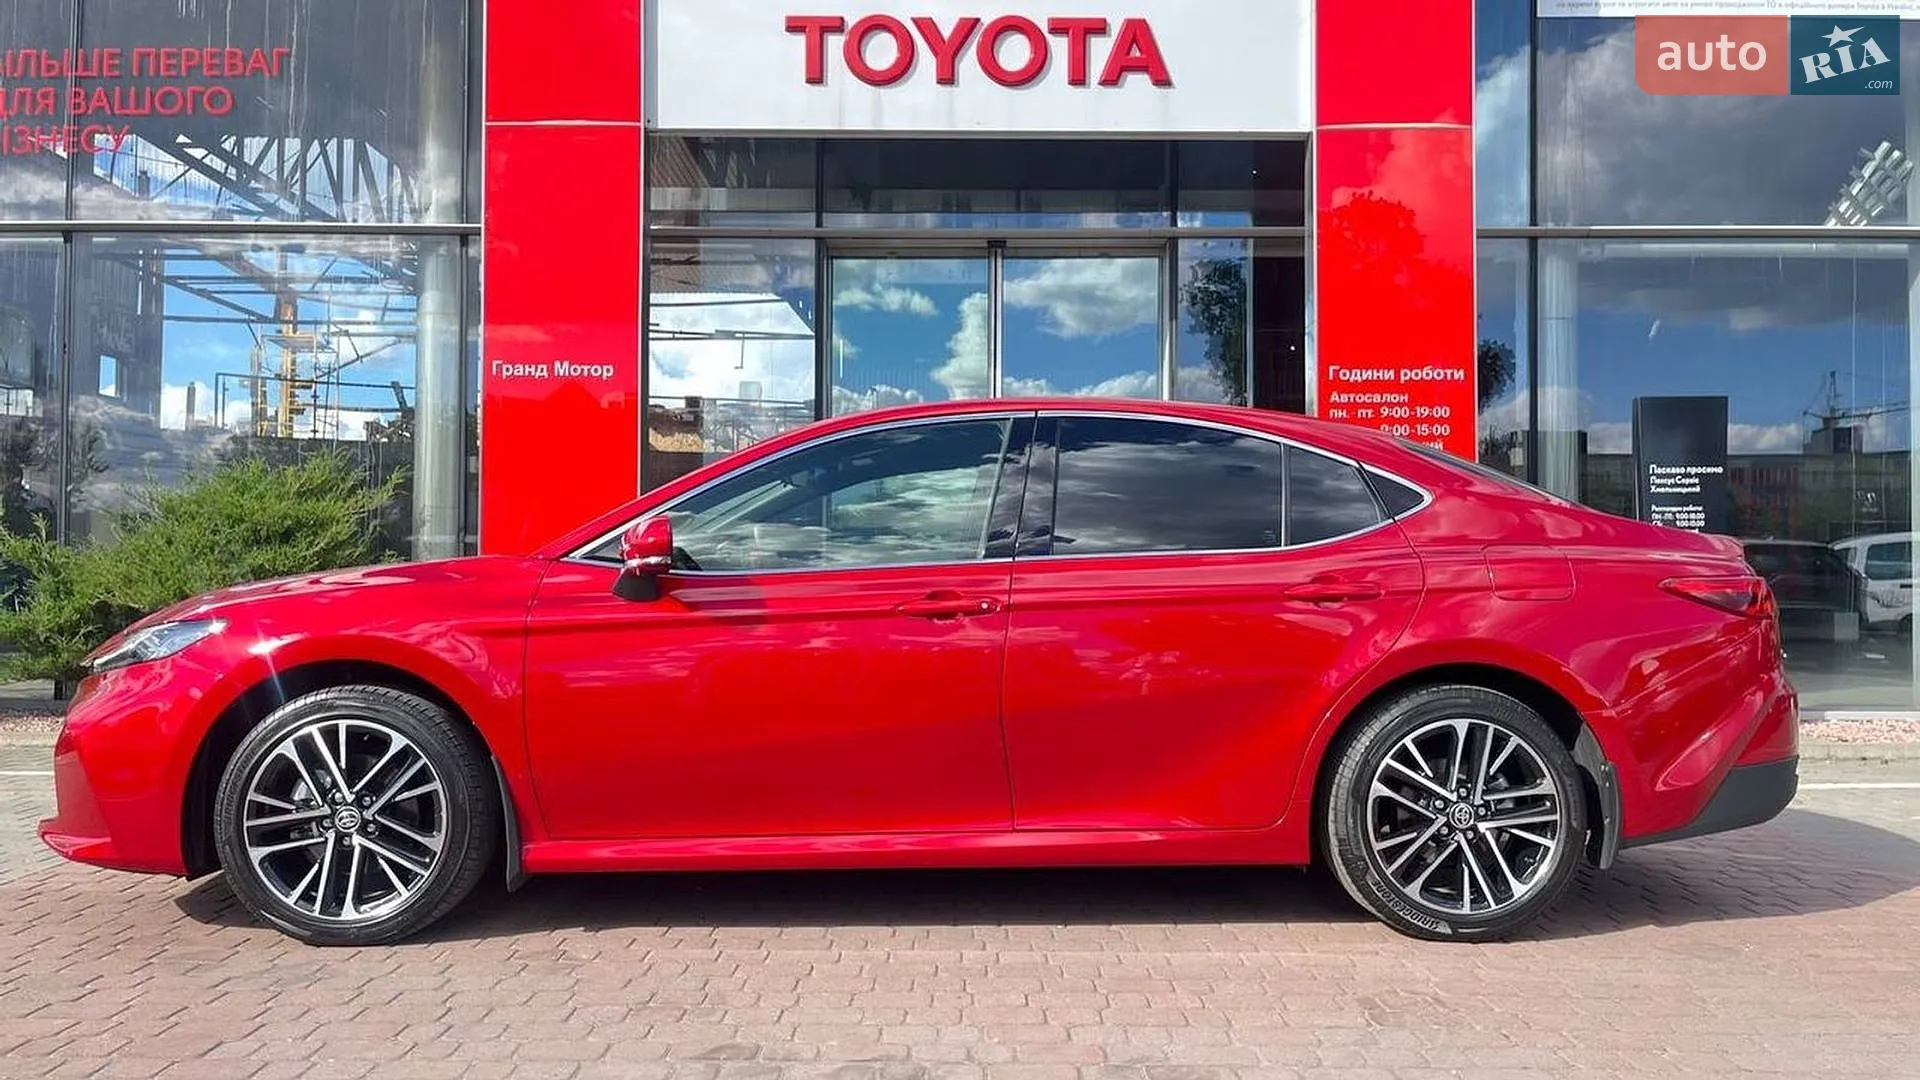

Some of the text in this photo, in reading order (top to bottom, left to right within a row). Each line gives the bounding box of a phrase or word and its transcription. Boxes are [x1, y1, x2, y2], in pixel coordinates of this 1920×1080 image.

[0, 46, 290, 78] ІЛЬШЕ ПЕРЕВАГ
[785, 14, 1173, 87] TOYOTA
[68, 86, 235, 116] ВАШОГО
[0, 124, 130, 156] ІЗНЕСУ
[491, 360, 614, 380] Гранд Мотор
[1328, 365, 1465, 383] Години роботи
[1330, 391, 1409, 404] Автосалон
[1370, 878, 1441, 931] BRIDGESTONE
